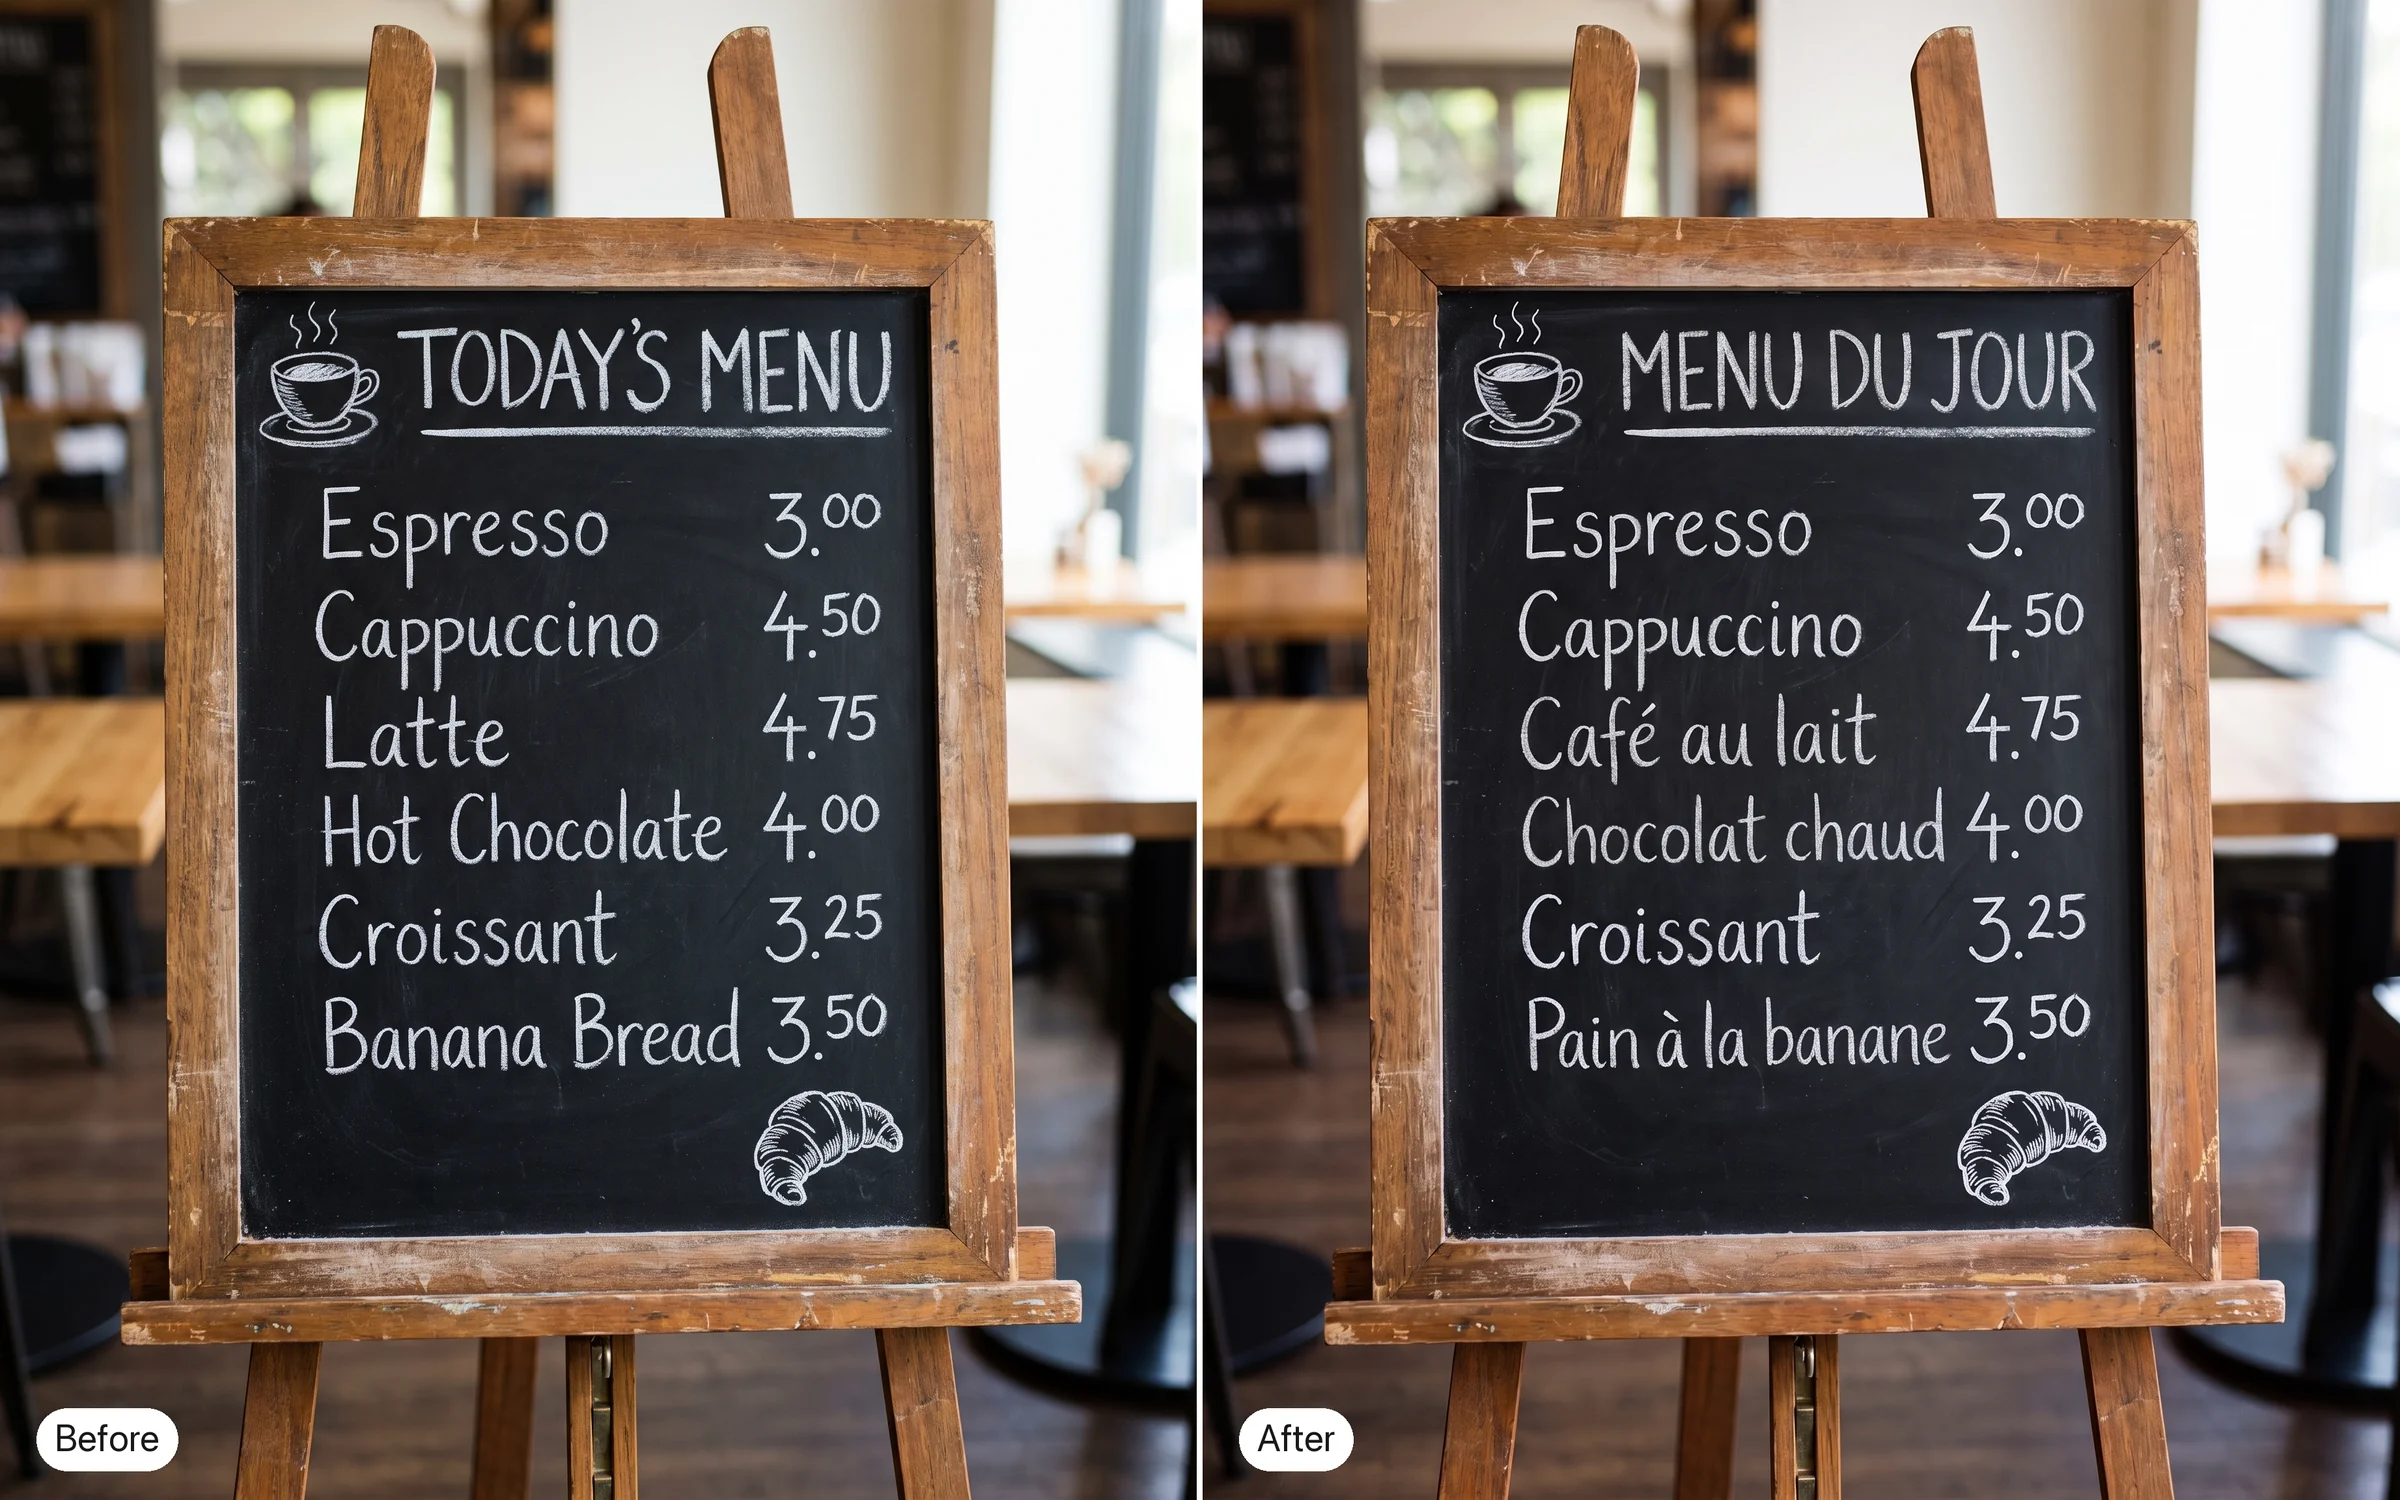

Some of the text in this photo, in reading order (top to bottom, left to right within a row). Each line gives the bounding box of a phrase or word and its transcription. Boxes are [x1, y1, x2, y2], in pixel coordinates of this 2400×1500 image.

[396, 317, 892, 415] TODAY'S MENU
[1621, 327, 2097, 414] MENU DU JOUR
[322, 486, 882, 590] Espresso 3.00
[1525, 486, 2085, 590] Espresso 3.00
[315, 589, 882, 693] Cappuccino 4.50
[1518, 589, 2085, 692] Cappuccino 4.50
[325, 692, 878, 769] Latte 4.75
[1520, 692, 2082, 786] Café au lait 4.75
[322, 787, 881, 867] Hot Chocolate 4.00
[1522, 786, 2084, 868] Chocolat chaud 4.00
[318, 889, 883, 970] Croissant 3.25
[1521, 889, 2087, 970] Croissant 3.25
[325, 986, 888, 1076] Banana Bread 3.50
[1528, 992, 2091, 1072] Pain à la banane 3.50
